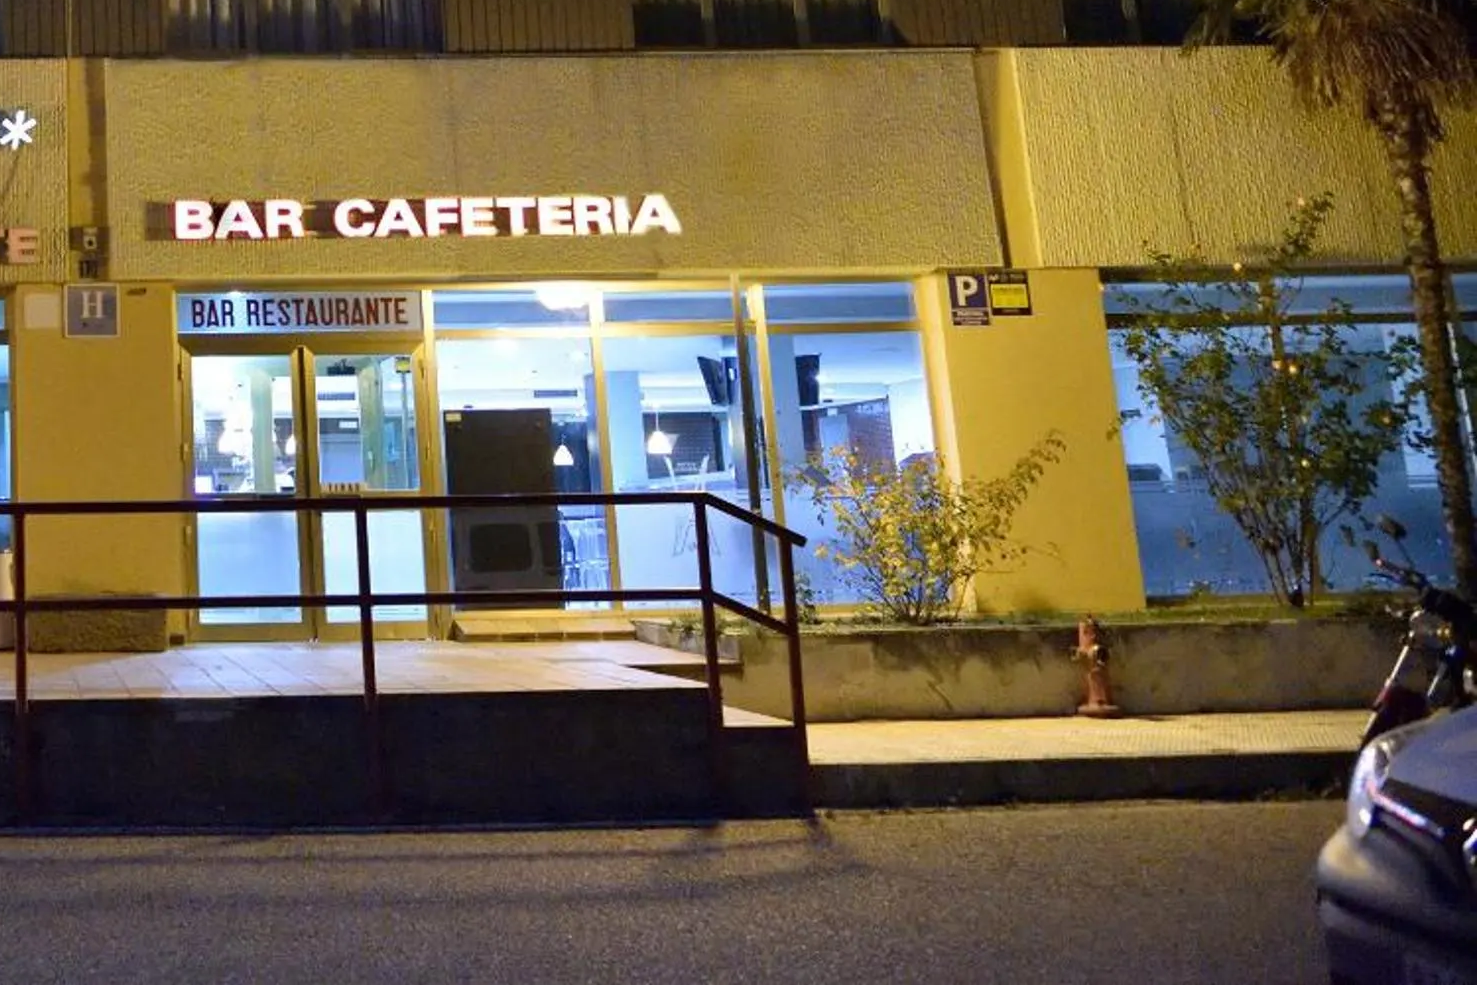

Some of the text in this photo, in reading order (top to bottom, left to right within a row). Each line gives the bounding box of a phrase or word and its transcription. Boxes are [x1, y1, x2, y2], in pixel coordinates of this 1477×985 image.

[174, 194, 682, 240] BAR CAFETERIA
[80, 290, 105, 319] H
[955, 275, 978, 307] P
[191, 297, 409, 328] BAR RESTAURANTE
